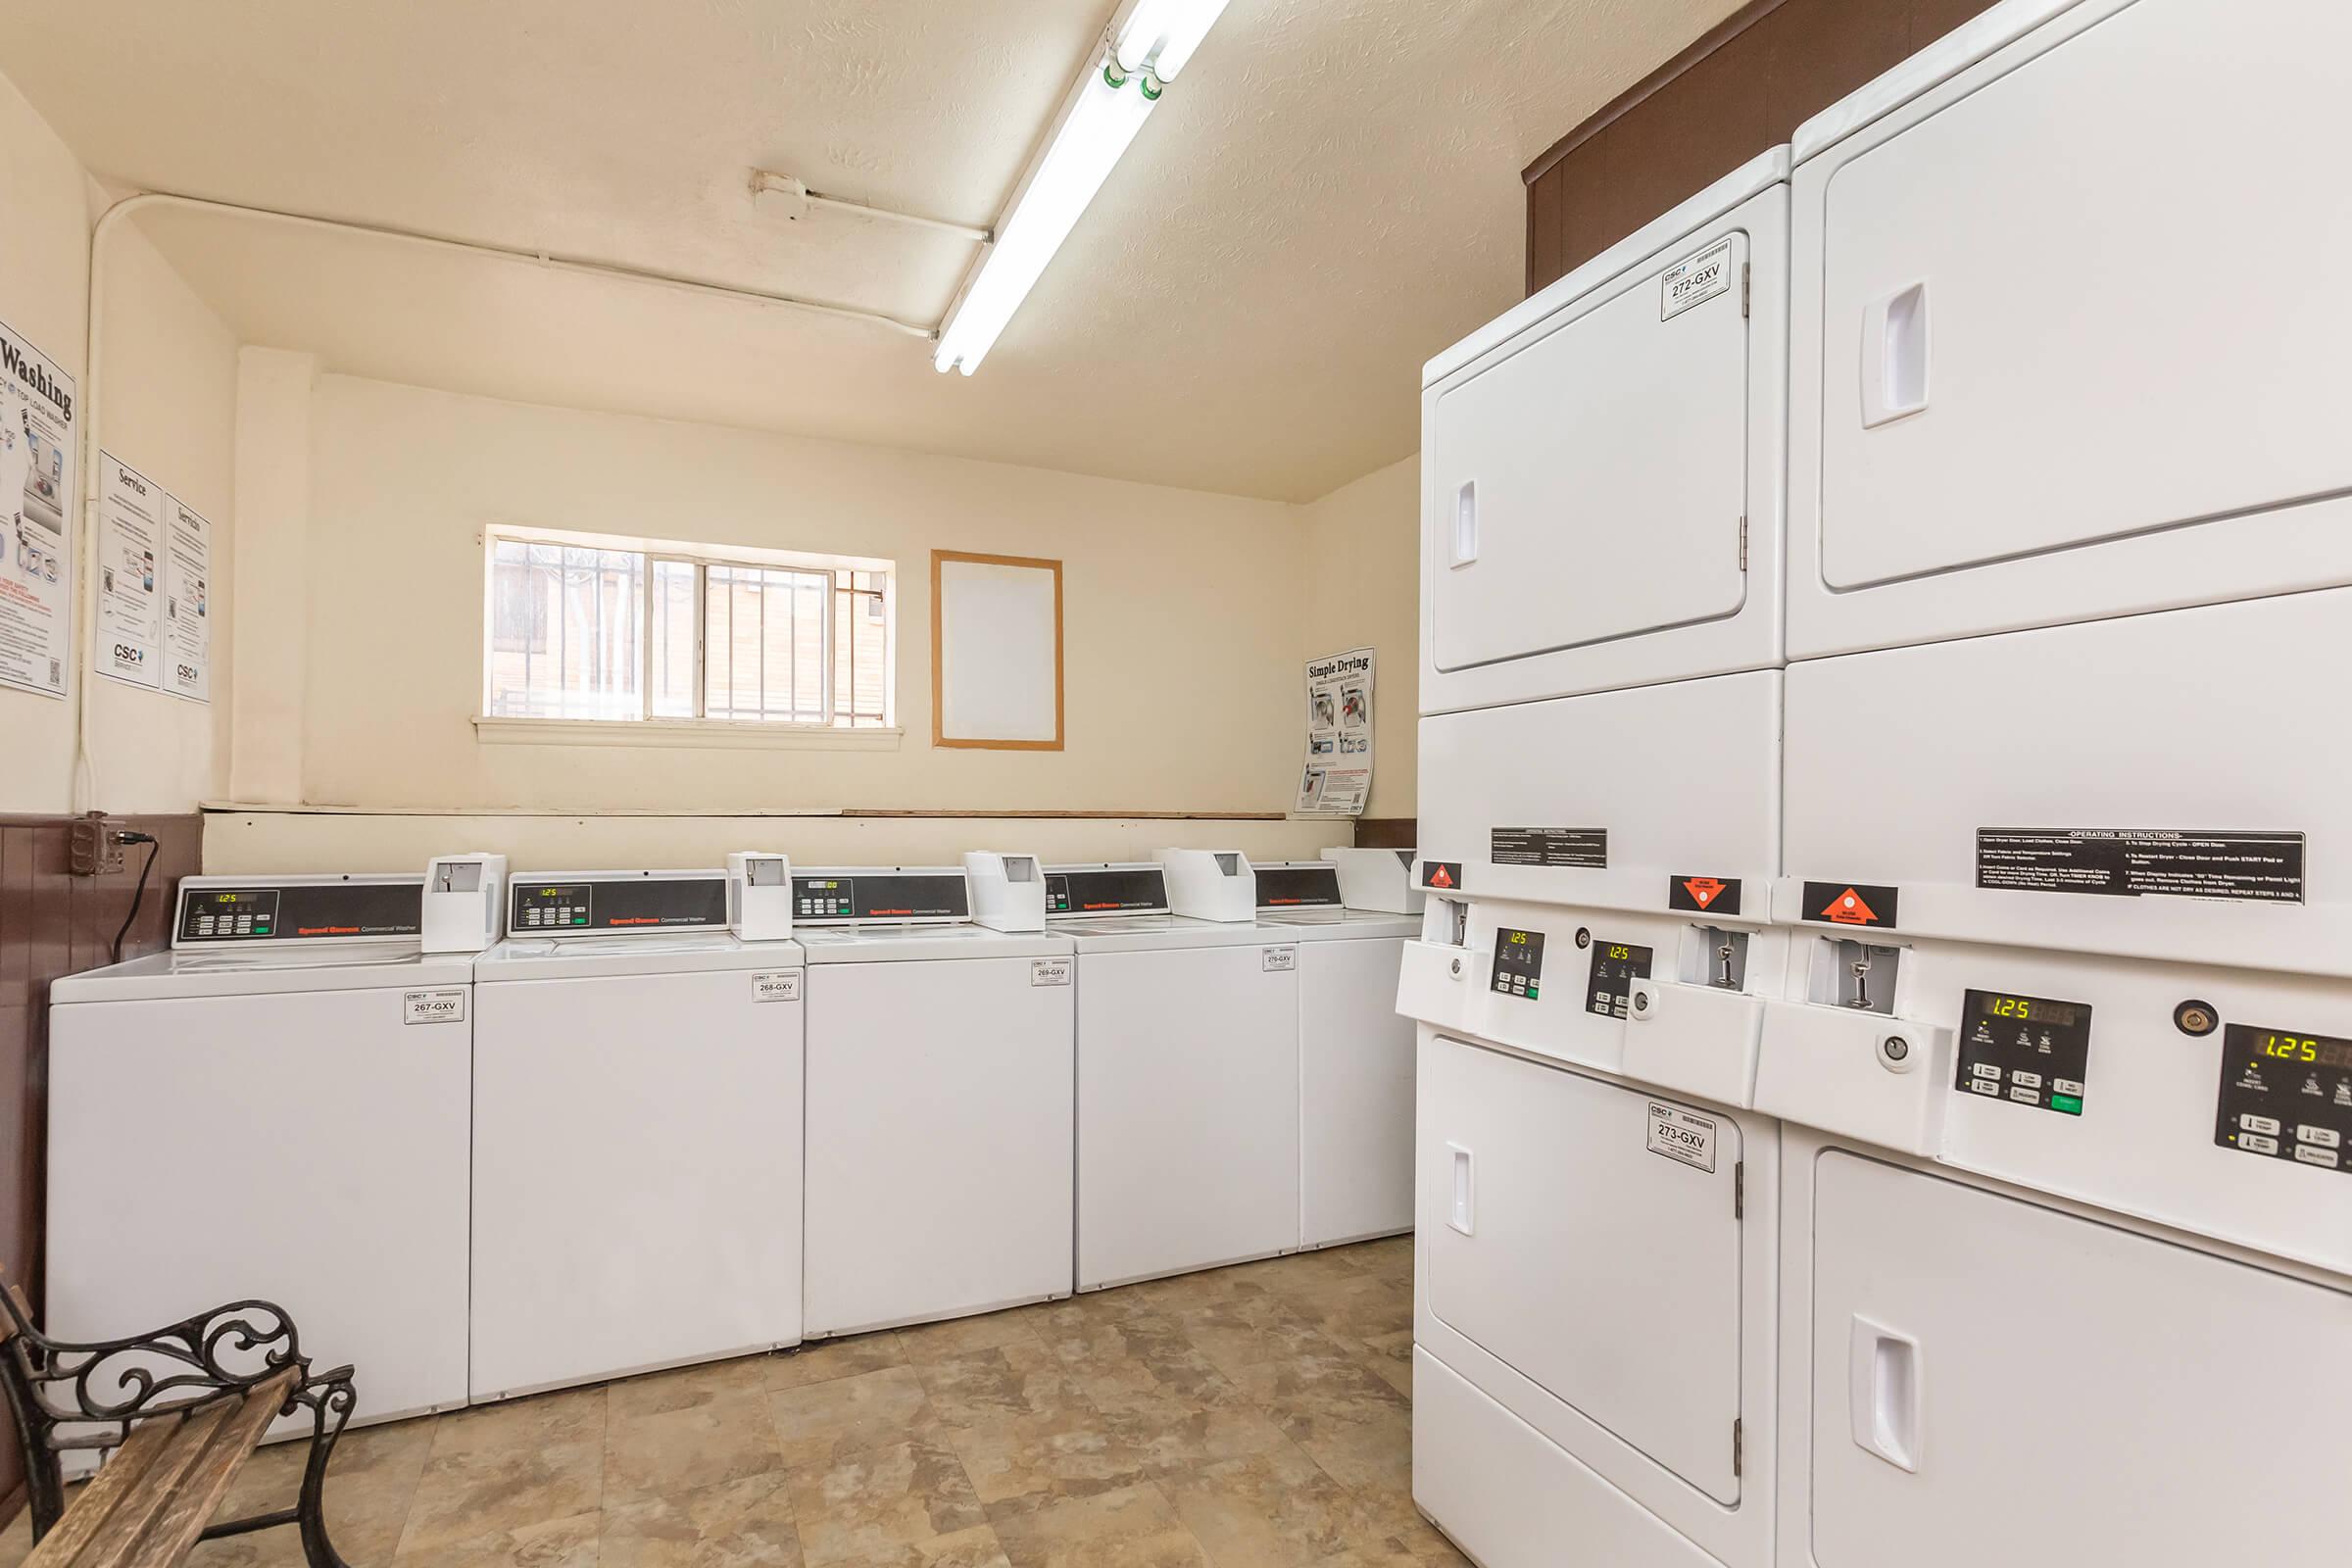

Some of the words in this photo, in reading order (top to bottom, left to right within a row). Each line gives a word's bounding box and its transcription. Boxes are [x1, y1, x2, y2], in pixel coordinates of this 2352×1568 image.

[1672, 263, 1720, 298] 272-GXV
[0, 336, 72, 422] Washing
[119, 468, 146, 496] Service
[114, 643, 137, 661] CSC
[177, 663, 193, 679] CSC
[1309, 662, 1336, 678] Simple
[1338, 657, 1369, 673] Drying
[1511, 932, 1527, 945] 1.25
[1609, 946, 1628, 960] 1.25
[415, 1003, 455, 1012] 267-GXV
[1993, 998, 2030, 1019] 1.25
[2266, 1036, 2318, 1061] 1.25
[1651, 1106, 1667, 1115] CSC
[1658, 1124, 1705, 1149] 273-GXV
